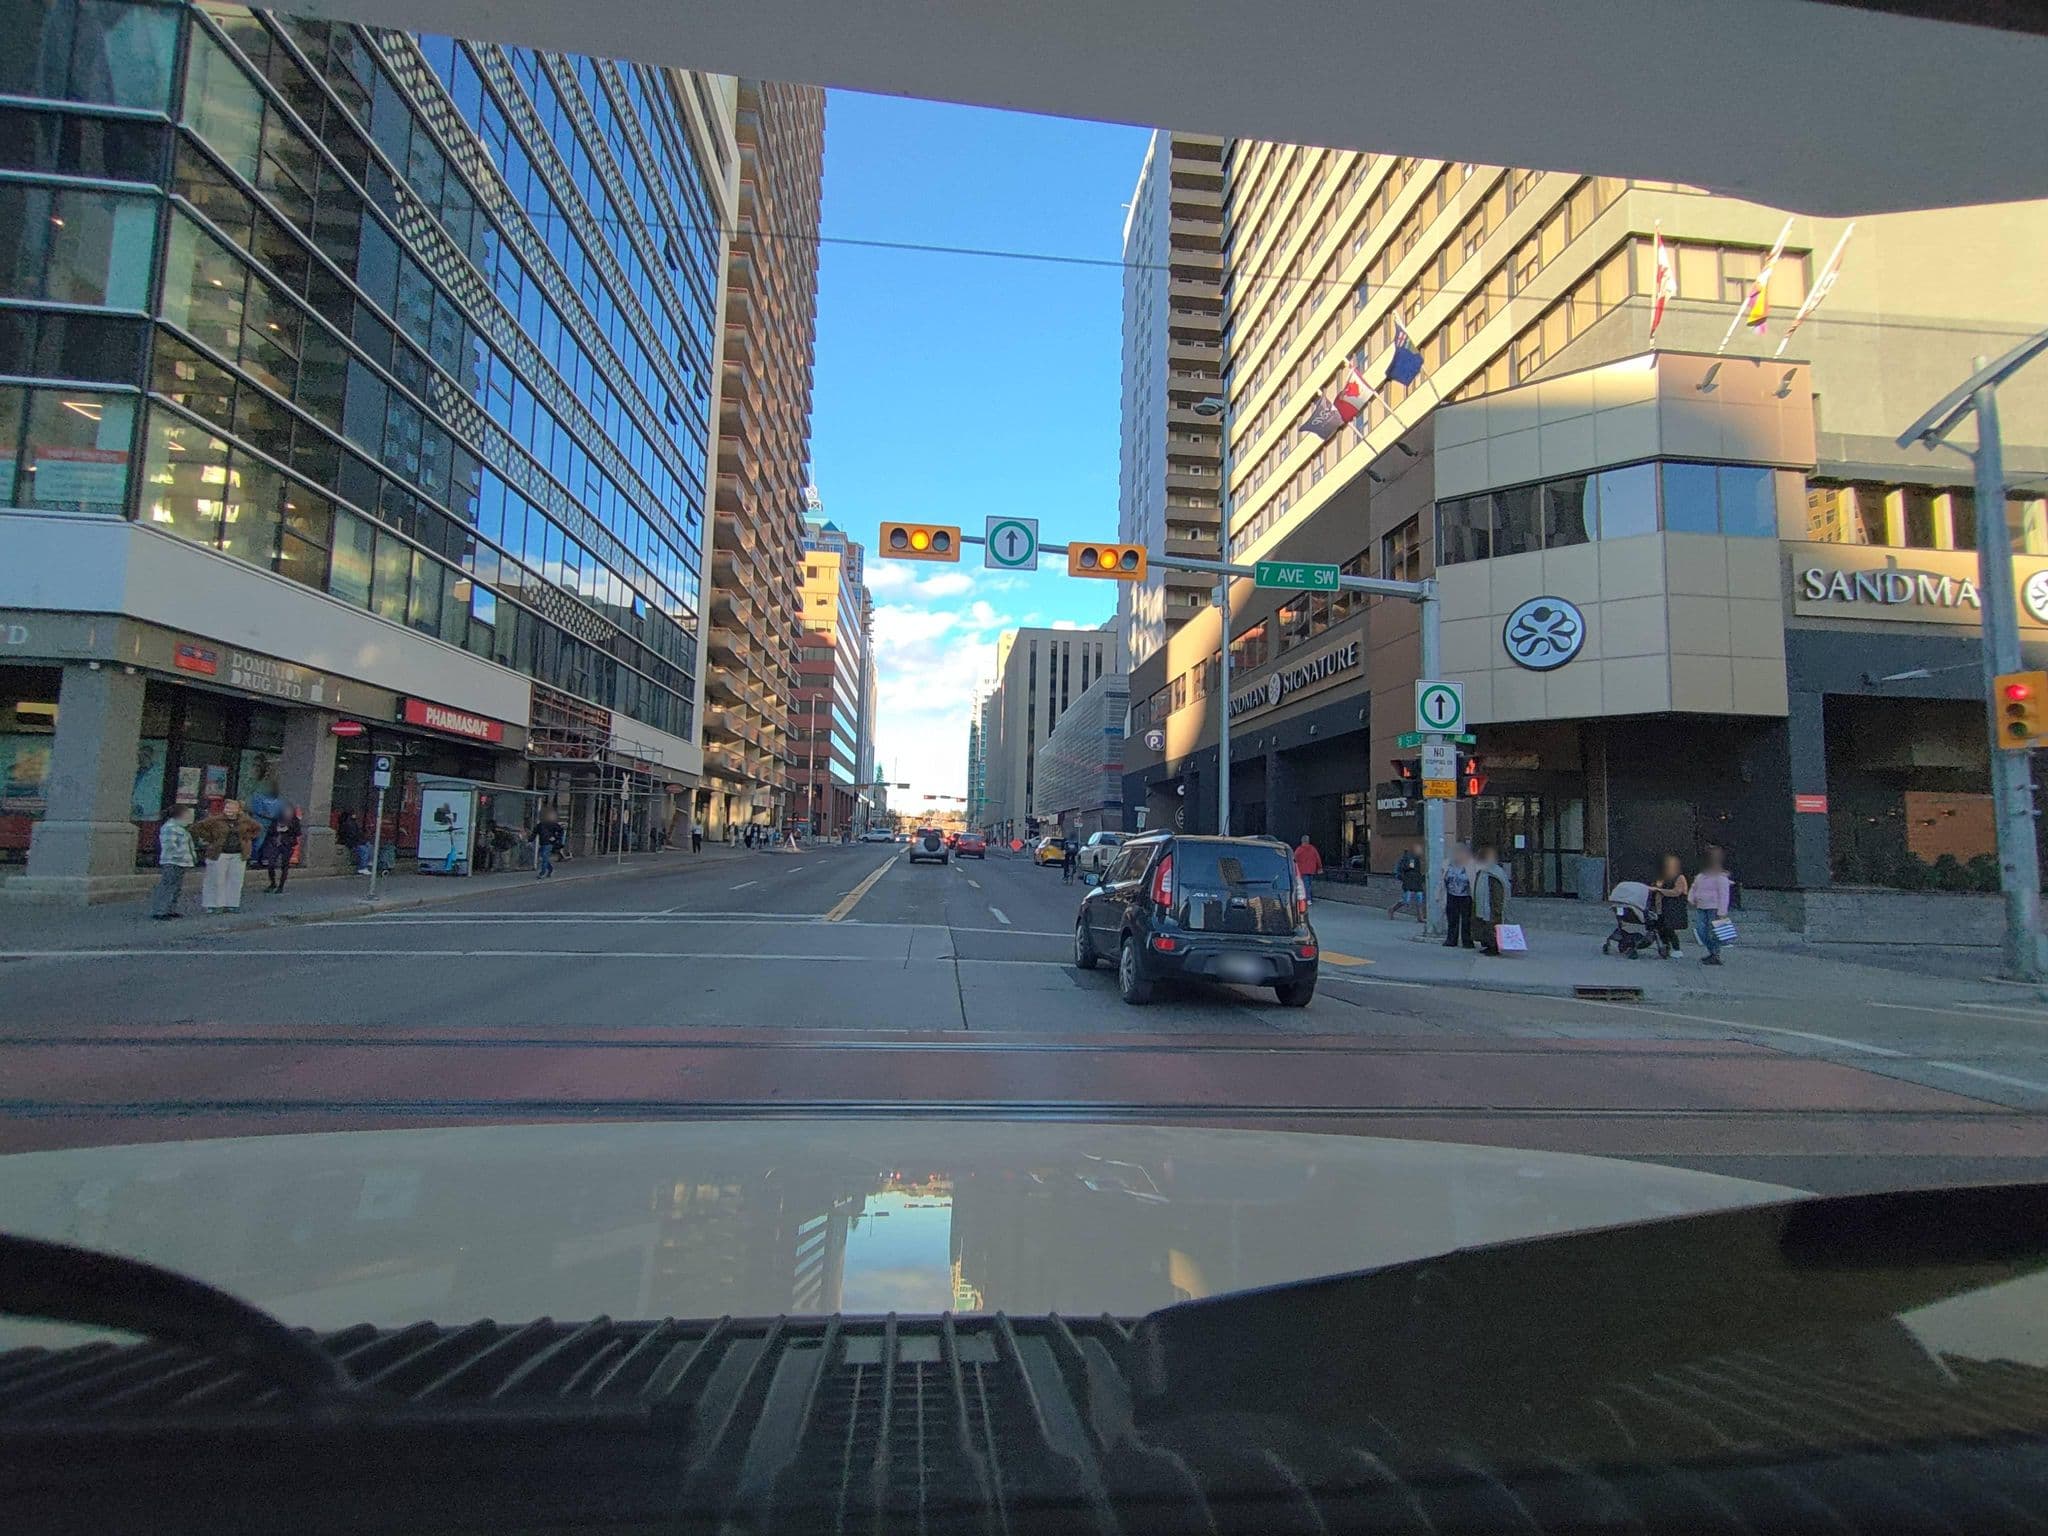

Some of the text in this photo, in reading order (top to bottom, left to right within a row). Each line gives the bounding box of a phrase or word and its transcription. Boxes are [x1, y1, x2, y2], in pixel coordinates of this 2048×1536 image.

[1260, 566, 1335, 585] 7 AVE SW
[1804, 567, 1982, 609] SANDMA
[231, 651, 302, 684] DOMINION
[1229, 641, 1359, 717] ANDMAN SIGNATURE
[230, 669, 302, 699] DRUG LTD
[426, 706, 490, 738] PHARMASAVE
[1433, 747, 1445, 757] NO
